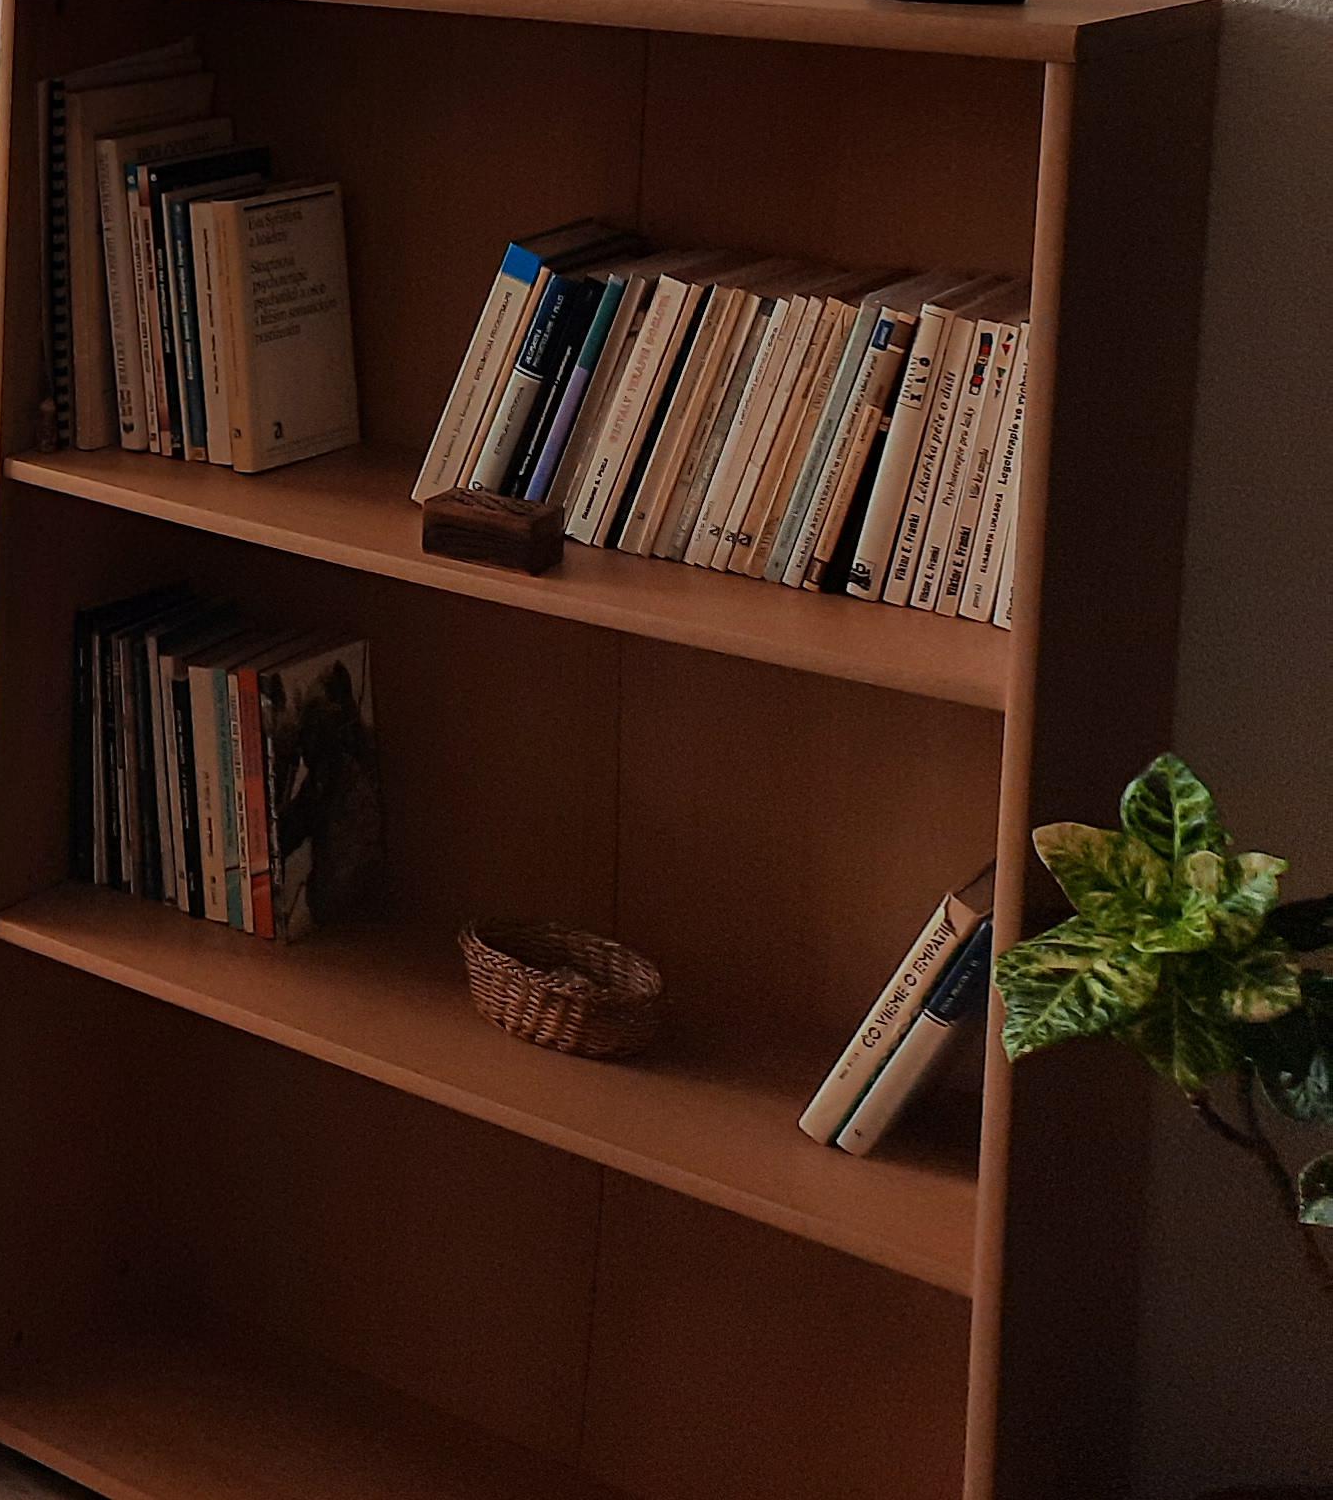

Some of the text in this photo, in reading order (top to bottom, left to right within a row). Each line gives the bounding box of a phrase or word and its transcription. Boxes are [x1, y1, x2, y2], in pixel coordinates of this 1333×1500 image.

[914, 445, 938, 505] Lékařská
[931, 412, 948, 446] péče
[940, 402, 948, 411] o
[942, 447, 967, 507] Psychoterapie
[997, 423, 1022, 486] Logoterapie
[894, 513, 921, 582] Viktor E. Frankl
[945, 526, 973, 597] Viktor E. Frankl
[861, 1026, 881, 1048] ČO
[875, 987, 910, 1025] VIEME
[904, 973, 917, 987] O
